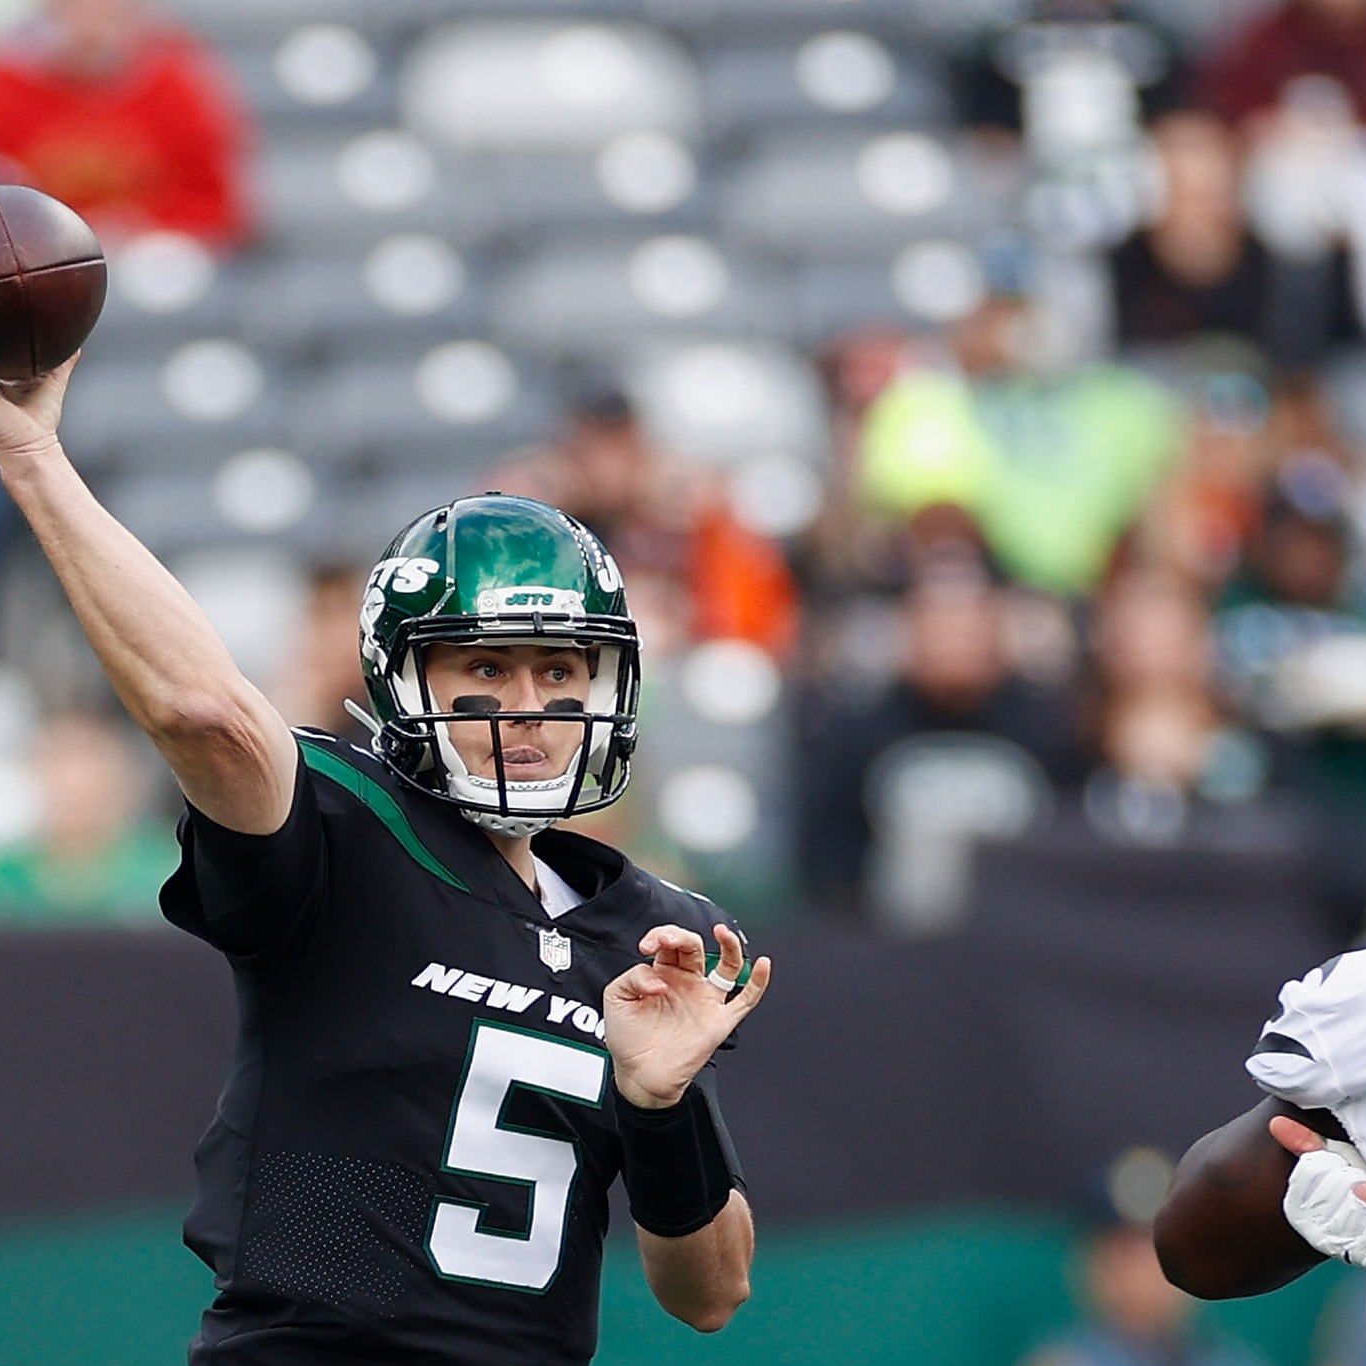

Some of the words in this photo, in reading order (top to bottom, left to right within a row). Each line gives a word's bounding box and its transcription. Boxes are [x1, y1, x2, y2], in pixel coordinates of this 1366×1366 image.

[505, 593, 554, 605] JETS
[411, 962, 545, 1014] NEW
[546, 995, 606, 1042] YO
[423, 1017, 611, 1294] 5
